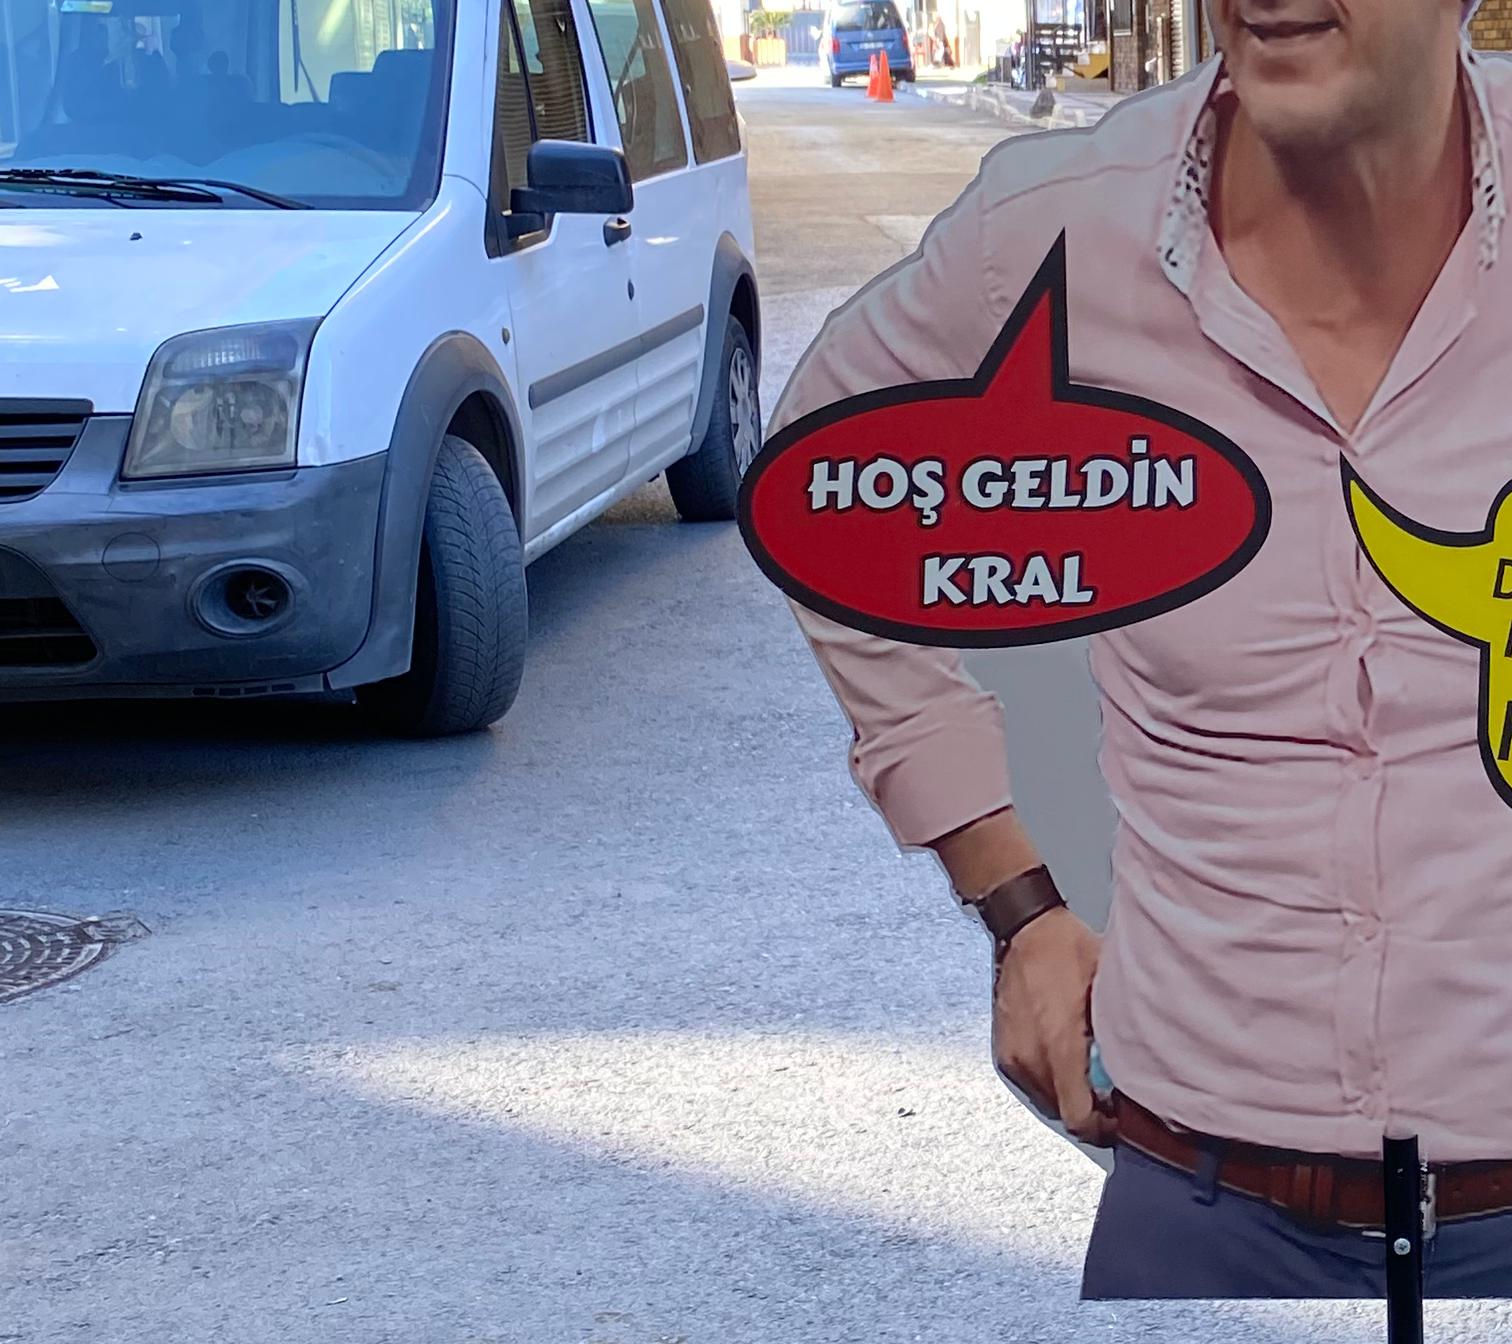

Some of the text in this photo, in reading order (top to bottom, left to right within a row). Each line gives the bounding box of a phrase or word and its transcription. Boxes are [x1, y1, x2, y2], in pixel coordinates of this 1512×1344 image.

[807, 439, 1194, 526] HOŞ GELDİN
[923, 555, 1094, 605] KRAL
